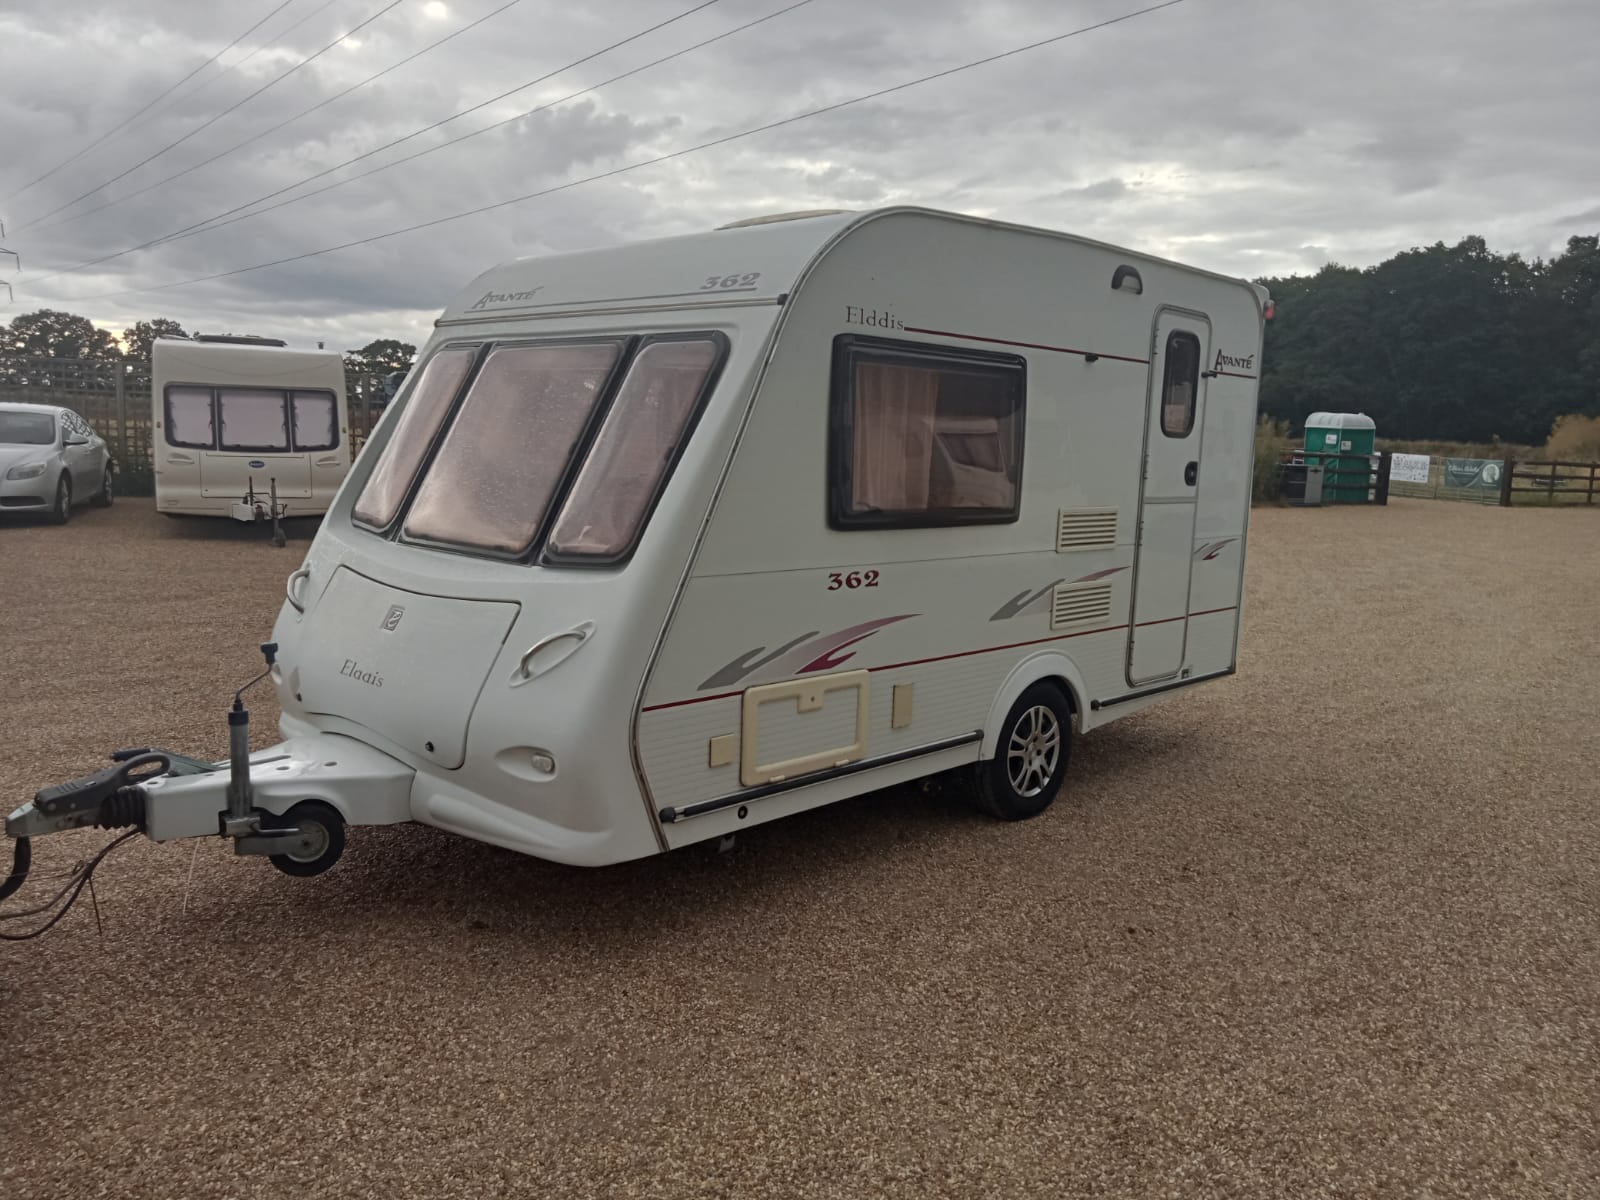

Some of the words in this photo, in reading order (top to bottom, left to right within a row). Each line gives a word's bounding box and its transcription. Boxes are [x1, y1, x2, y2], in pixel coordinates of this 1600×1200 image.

[700, 272, 761, 289] 362
[845, 305, 904, 330] Elddis
[827, 569, 880, 591] 362
